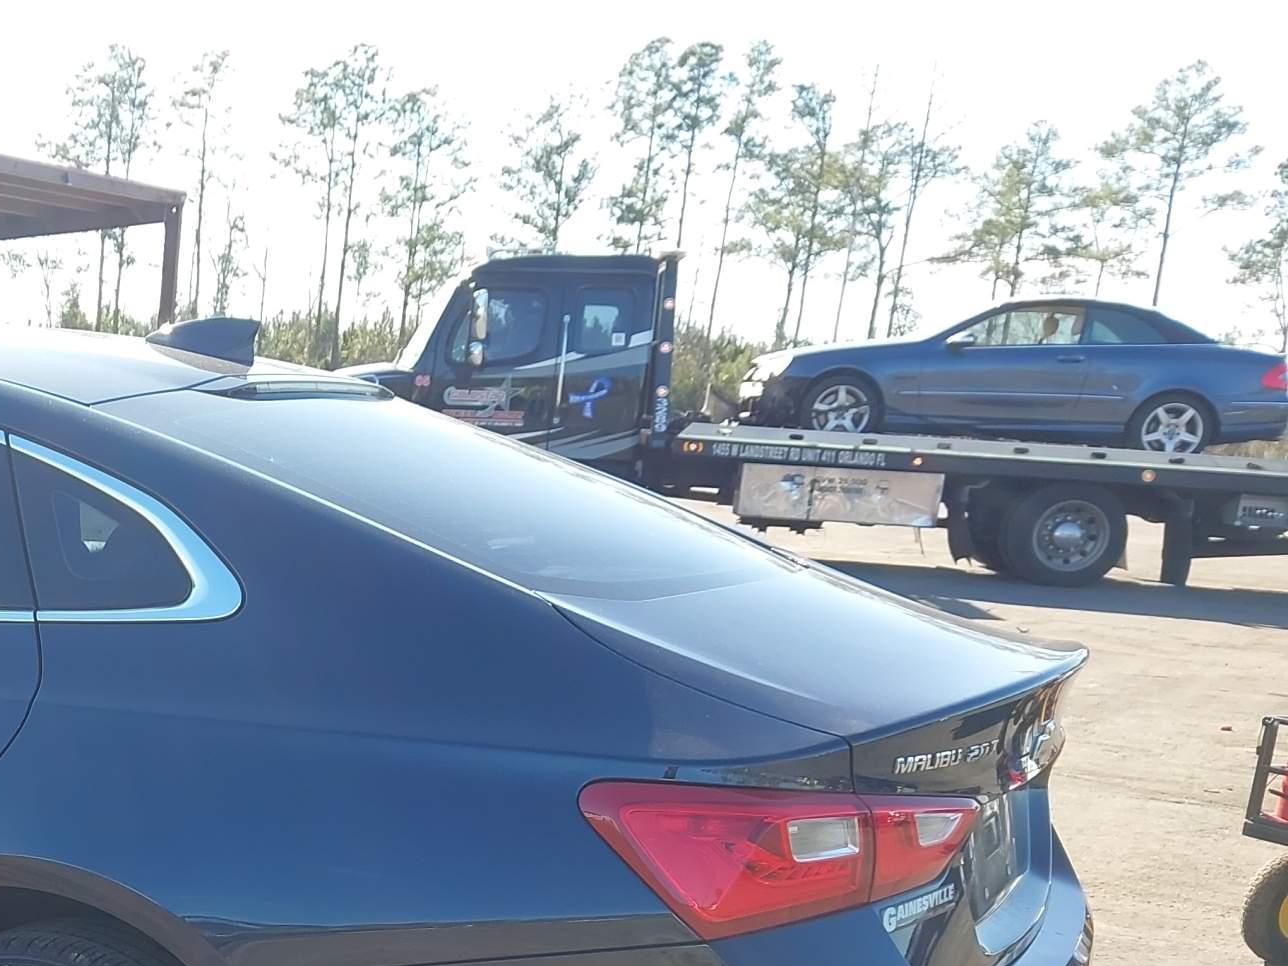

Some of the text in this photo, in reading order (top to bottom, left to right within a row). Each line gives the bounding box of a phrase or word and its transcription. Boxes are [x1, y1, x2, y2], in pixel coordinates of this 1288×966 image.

[739, 444, 789, 461] LANDSTREET
[838, 450, 876, 466] ORLANDO
[894, 748, 962, 775] MALIBU
[882, 883, 956, 933] GAINESVILLE
